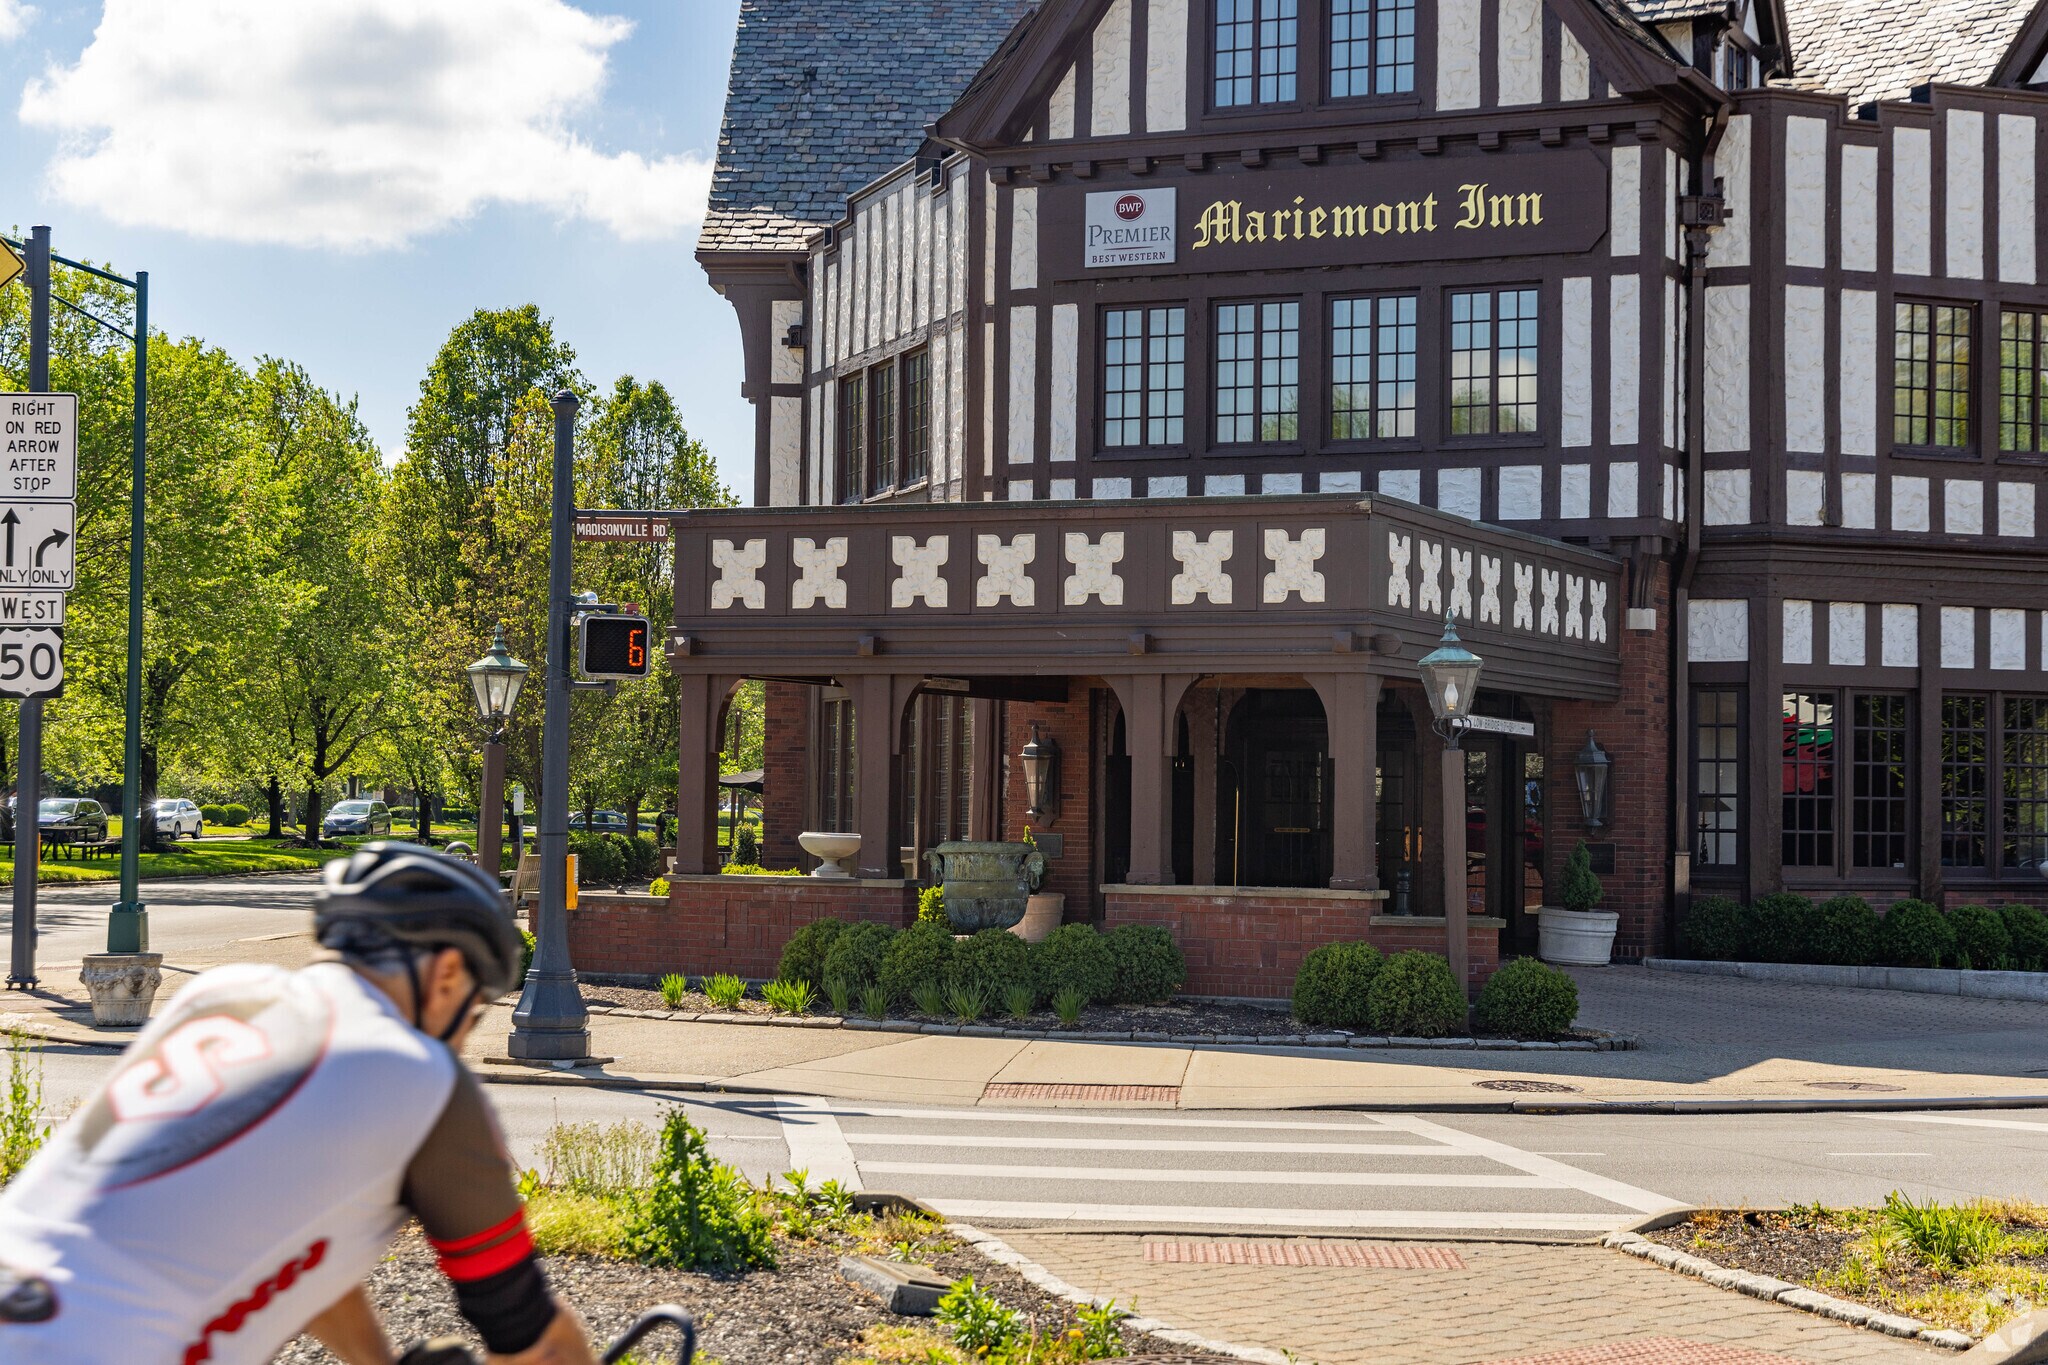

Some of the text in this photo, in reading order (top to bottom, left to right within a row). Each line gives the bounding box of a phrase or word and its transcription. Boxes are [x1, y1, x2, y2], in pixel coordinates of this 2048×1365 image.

[1119, 202, 1142, 213] BWP
[1193, 183, 1544, 250] Mariemont Inn
[1088, 224, 1171, 247] PREMIER
[1092, 251, 1166, 264] BEST WESTERN
[12, 402, 55, 416] RIGHT
[5, 421, 61, 434] ON RED
[7, 440, 60, 453] ARROW
[9, 459, 56, 472] AFTER
[13, 477, 51, 490] STOP
[576, 523, 668, 537] MADISONVILLE RD.
[0, 569, 28, 583] NLY
[32, 569, 70, 583] ONLY
[2, 597, 57, 619] WEST
[629, 630, 644, 666] 6
[0, 642, 56, 681] 50
